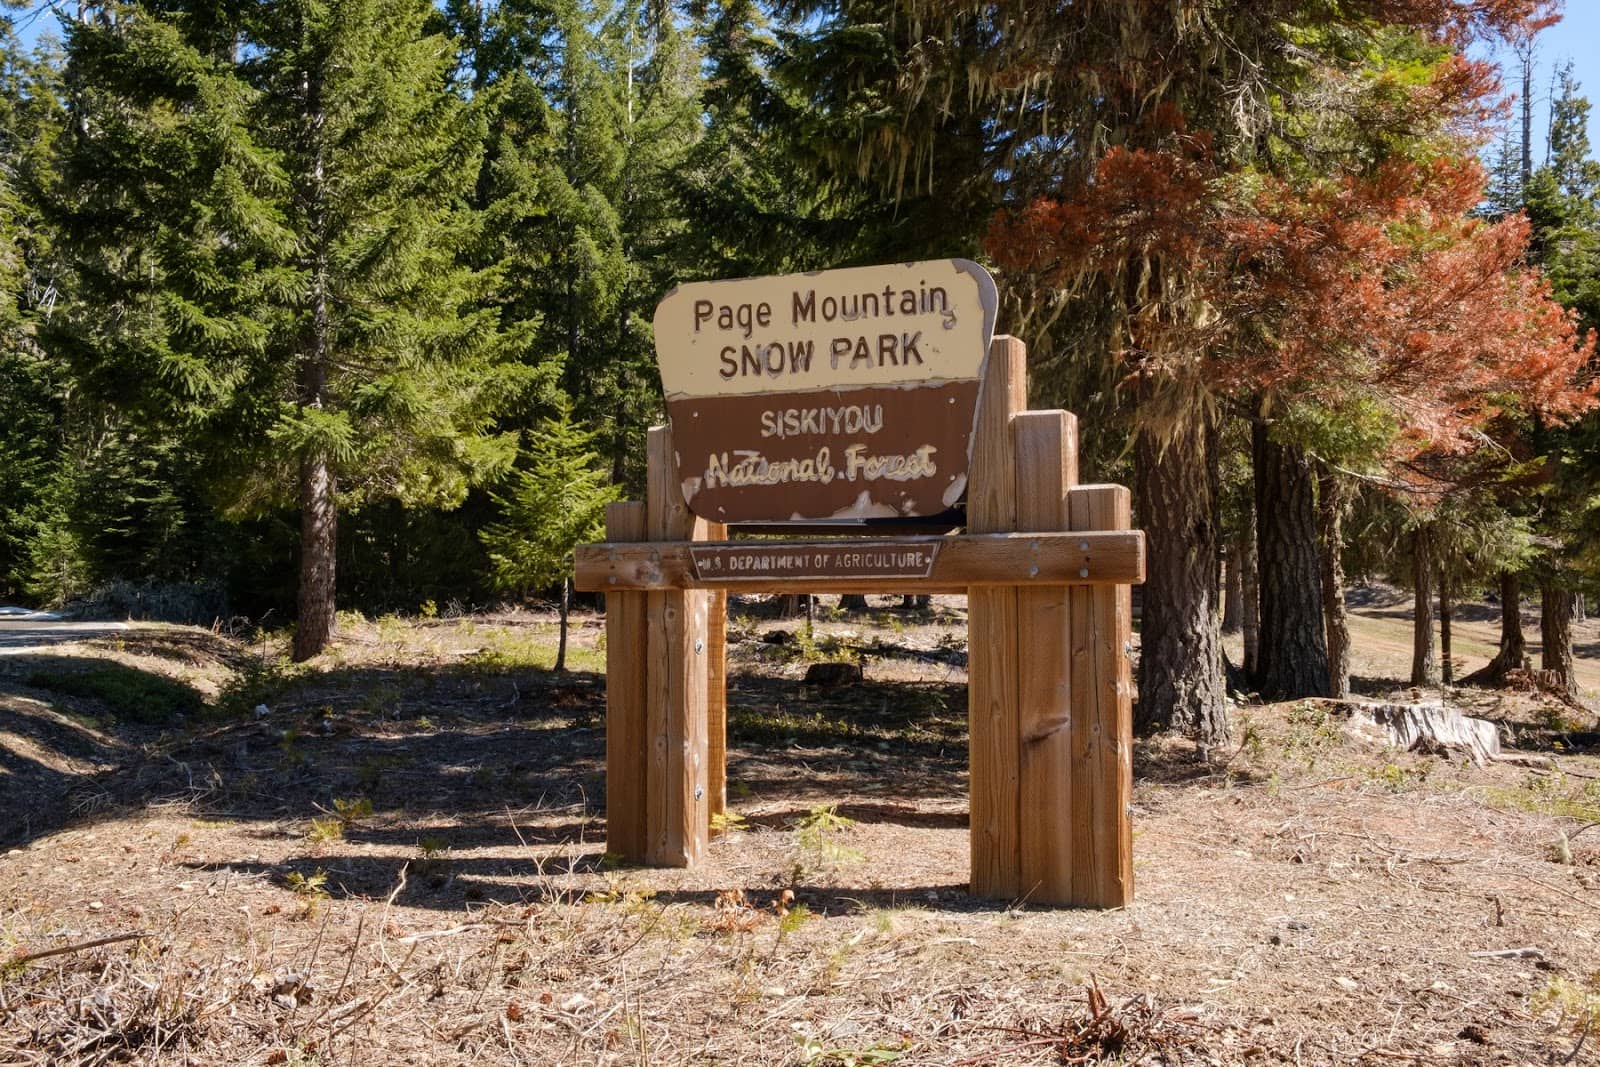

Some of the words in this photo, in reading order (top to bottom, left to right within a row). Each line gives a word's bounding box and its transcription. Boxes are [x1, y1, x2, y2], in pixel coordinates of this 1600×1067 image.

[694, 300, 772, 338] Page
[791, 280, 948, 325] Mountain
[719, 339, 814, 380] SNOW
[830, 330, 924, 370] PARK
[760, 404, 883, 439] SISKIYOU
[704, 446, 834, 488] National
[844, 444, 938, 483] Forest
[729, 554, 810, 571] DEPARTMENT
[814, 553, 831, 568] OF
[835, 551, 923, 568] AGRICULTURE
